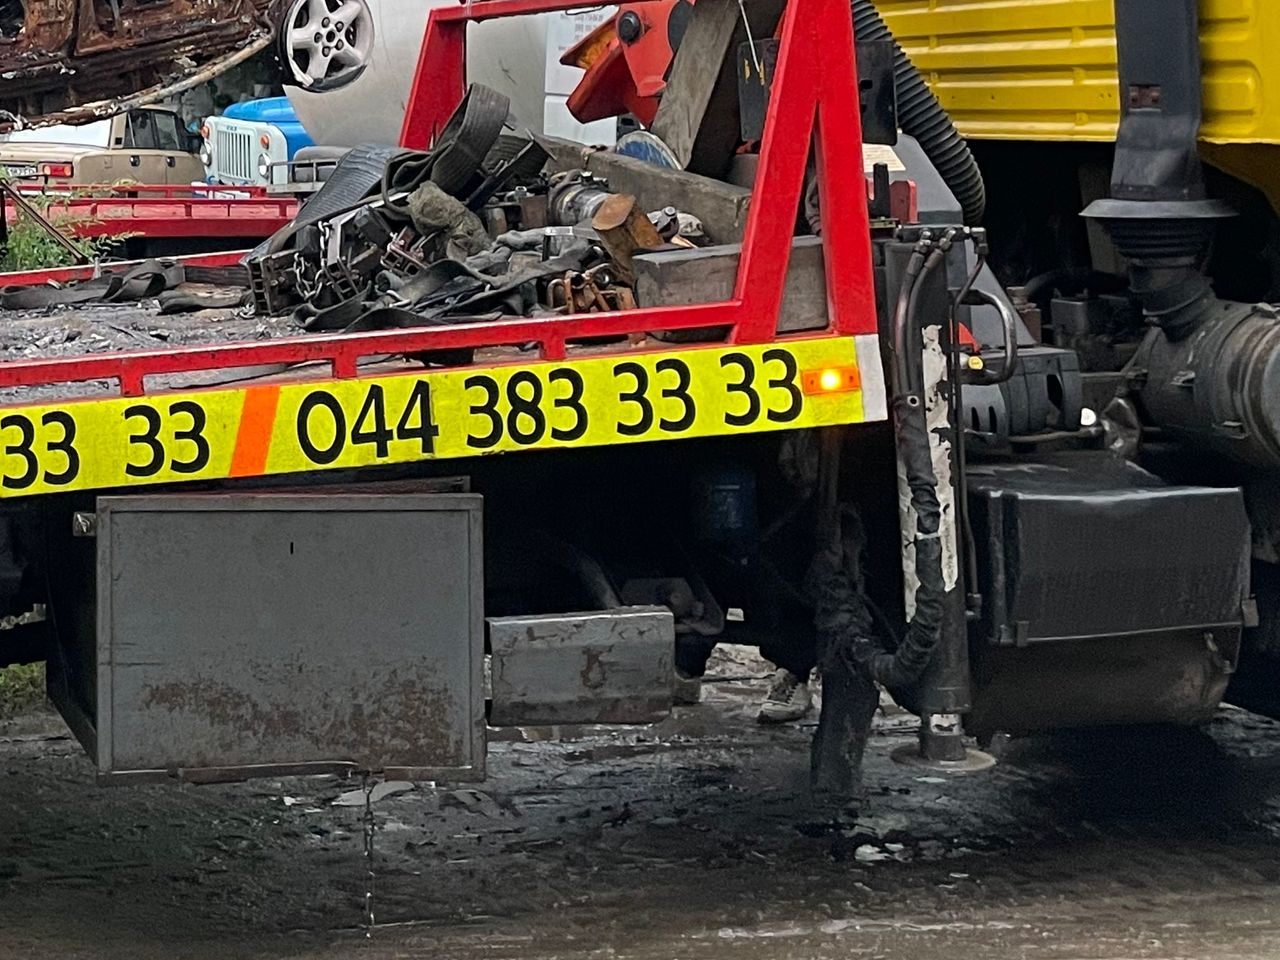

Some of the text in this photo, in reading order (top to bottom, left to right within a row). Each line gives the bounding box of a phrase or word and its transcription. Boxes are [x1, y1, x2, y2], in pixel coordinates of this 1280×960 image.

[1, 411, 80, 489] 33
[123, 401, 210, 477] 33
[297, 349, 802, 465] 044 383 33 33
